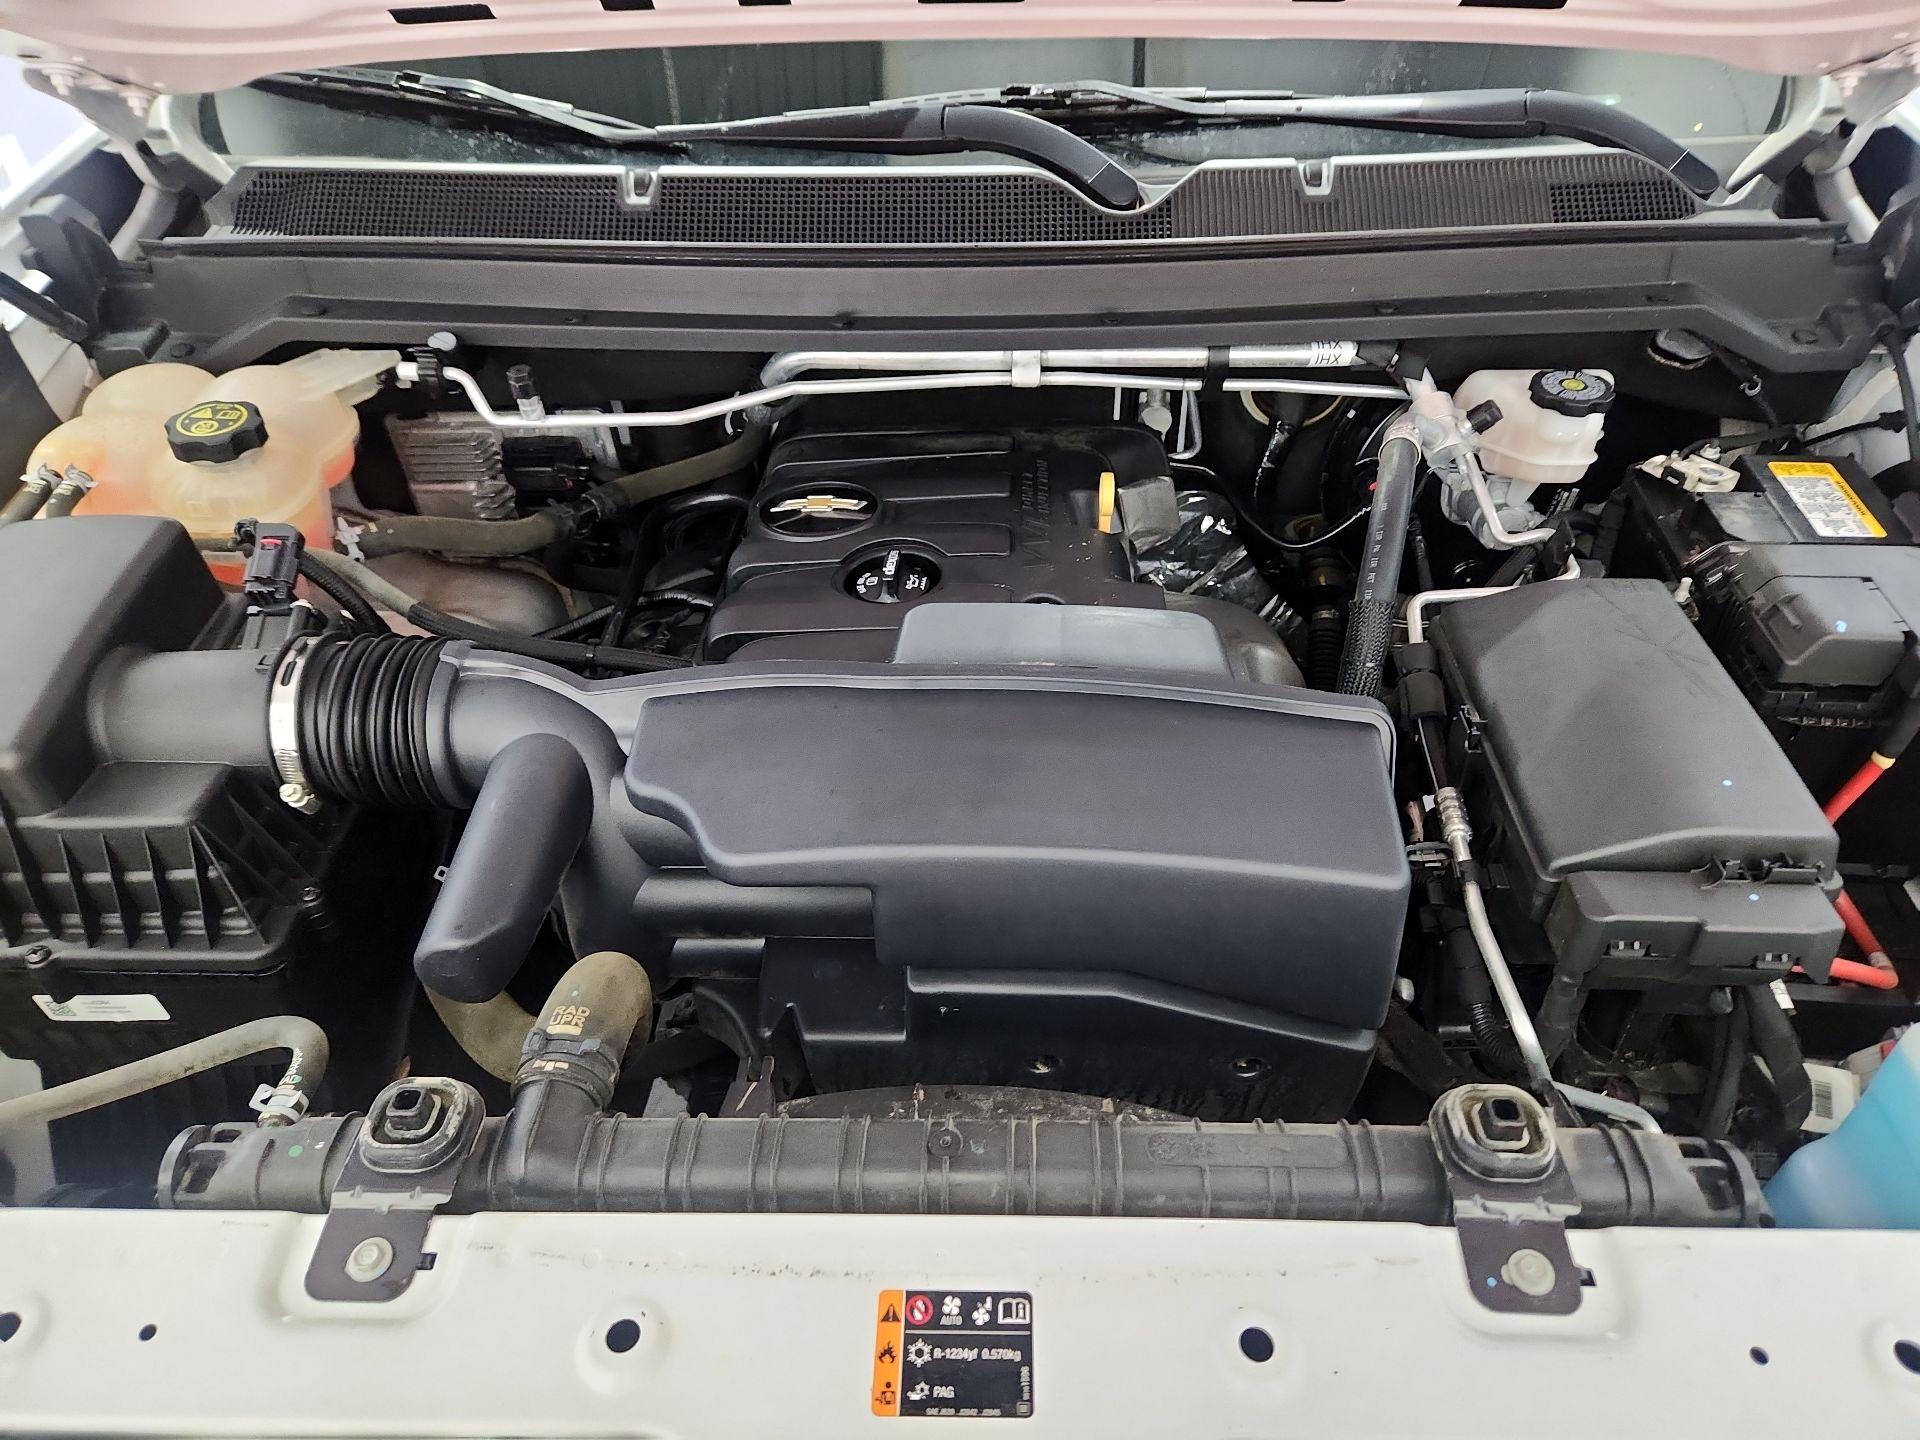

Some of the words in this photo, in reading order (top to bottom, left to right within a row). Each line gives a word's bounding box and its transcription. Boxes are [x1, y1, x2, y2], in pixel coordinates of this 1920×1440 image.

[553, 1005, 590, 1017] RAD
[550, 1014, 585, 1028] UPR
[940, 1315, 962, 1325] AUTO
[933, 1385, 955, 1398] PAG
